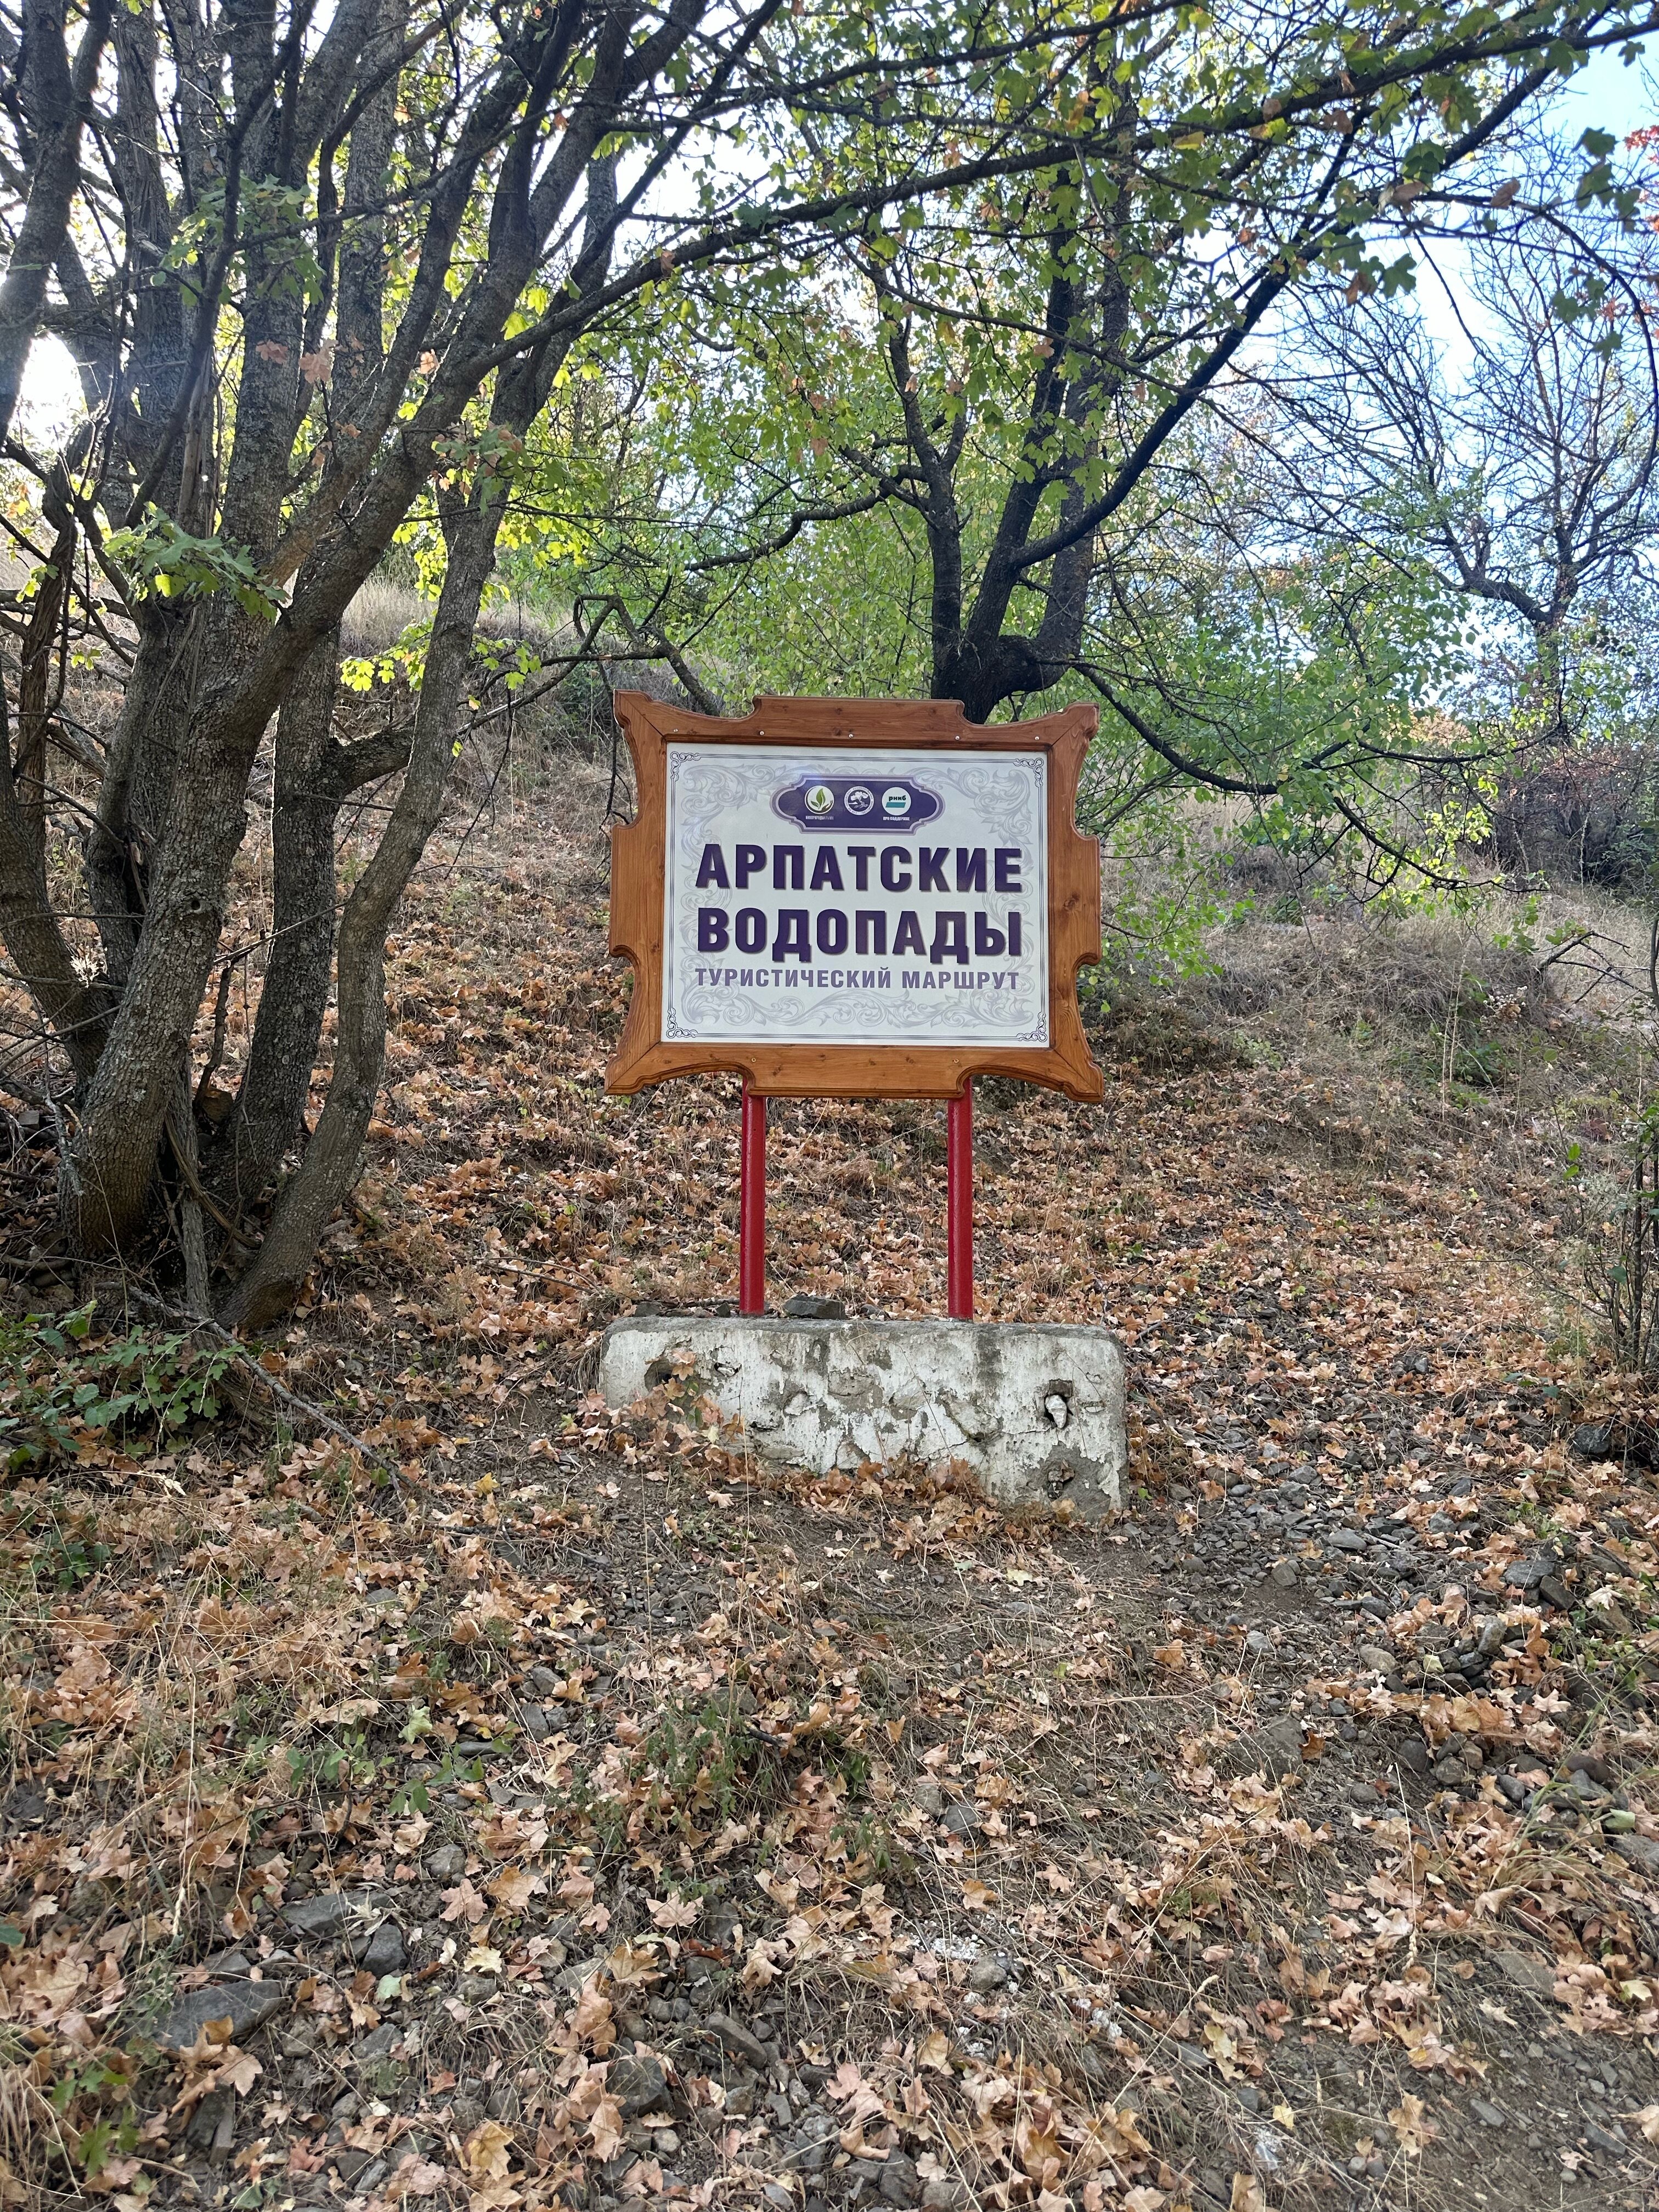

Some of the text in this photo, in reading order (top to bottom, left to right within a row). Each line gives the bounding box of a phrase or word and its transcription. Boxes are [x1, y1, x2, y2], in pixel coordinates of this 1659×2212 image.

[695, 843, 1022, 893] АРПАТСКИЕ
[697, 908, 1022, 963] ВОДОПАДЫ
[695, 966, 1019, 990] ТУРИСТИЧЕСКИЙ МАРШРУТ
